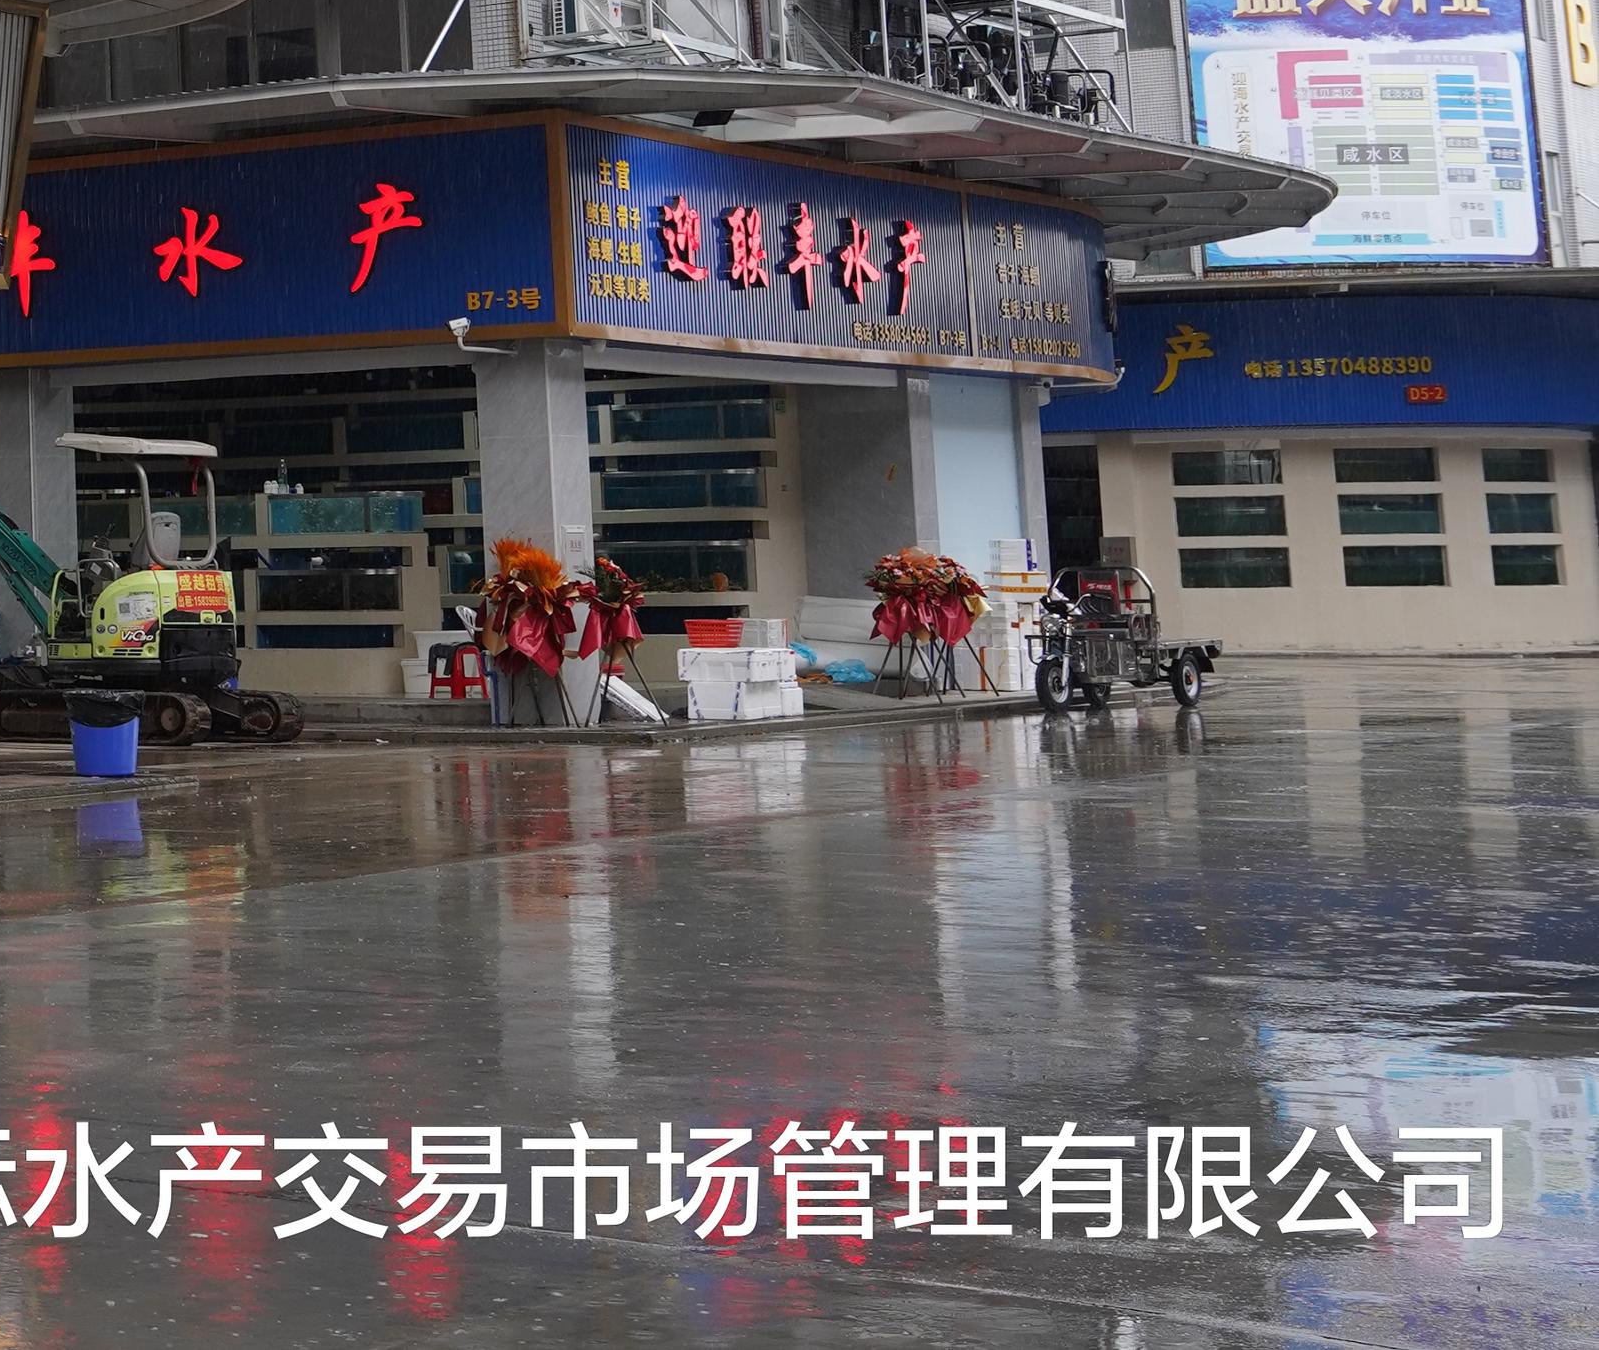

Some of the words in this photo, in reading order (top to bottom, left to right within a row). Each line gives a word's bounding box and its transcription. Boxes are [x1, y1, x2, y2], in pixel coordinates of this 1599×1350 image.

[1342, 146, 1406, 163] 咸水区
[598, 158, 630, 190] 主营
[466, 287, 542, 311] B7-3号
[1152, 324, 1214, 394] 产
[1244, 361, 1283, 378] 电话
[1288, 356, 1433, 378] 13570488390
[1409, 386, 1445, 401] D5-2
